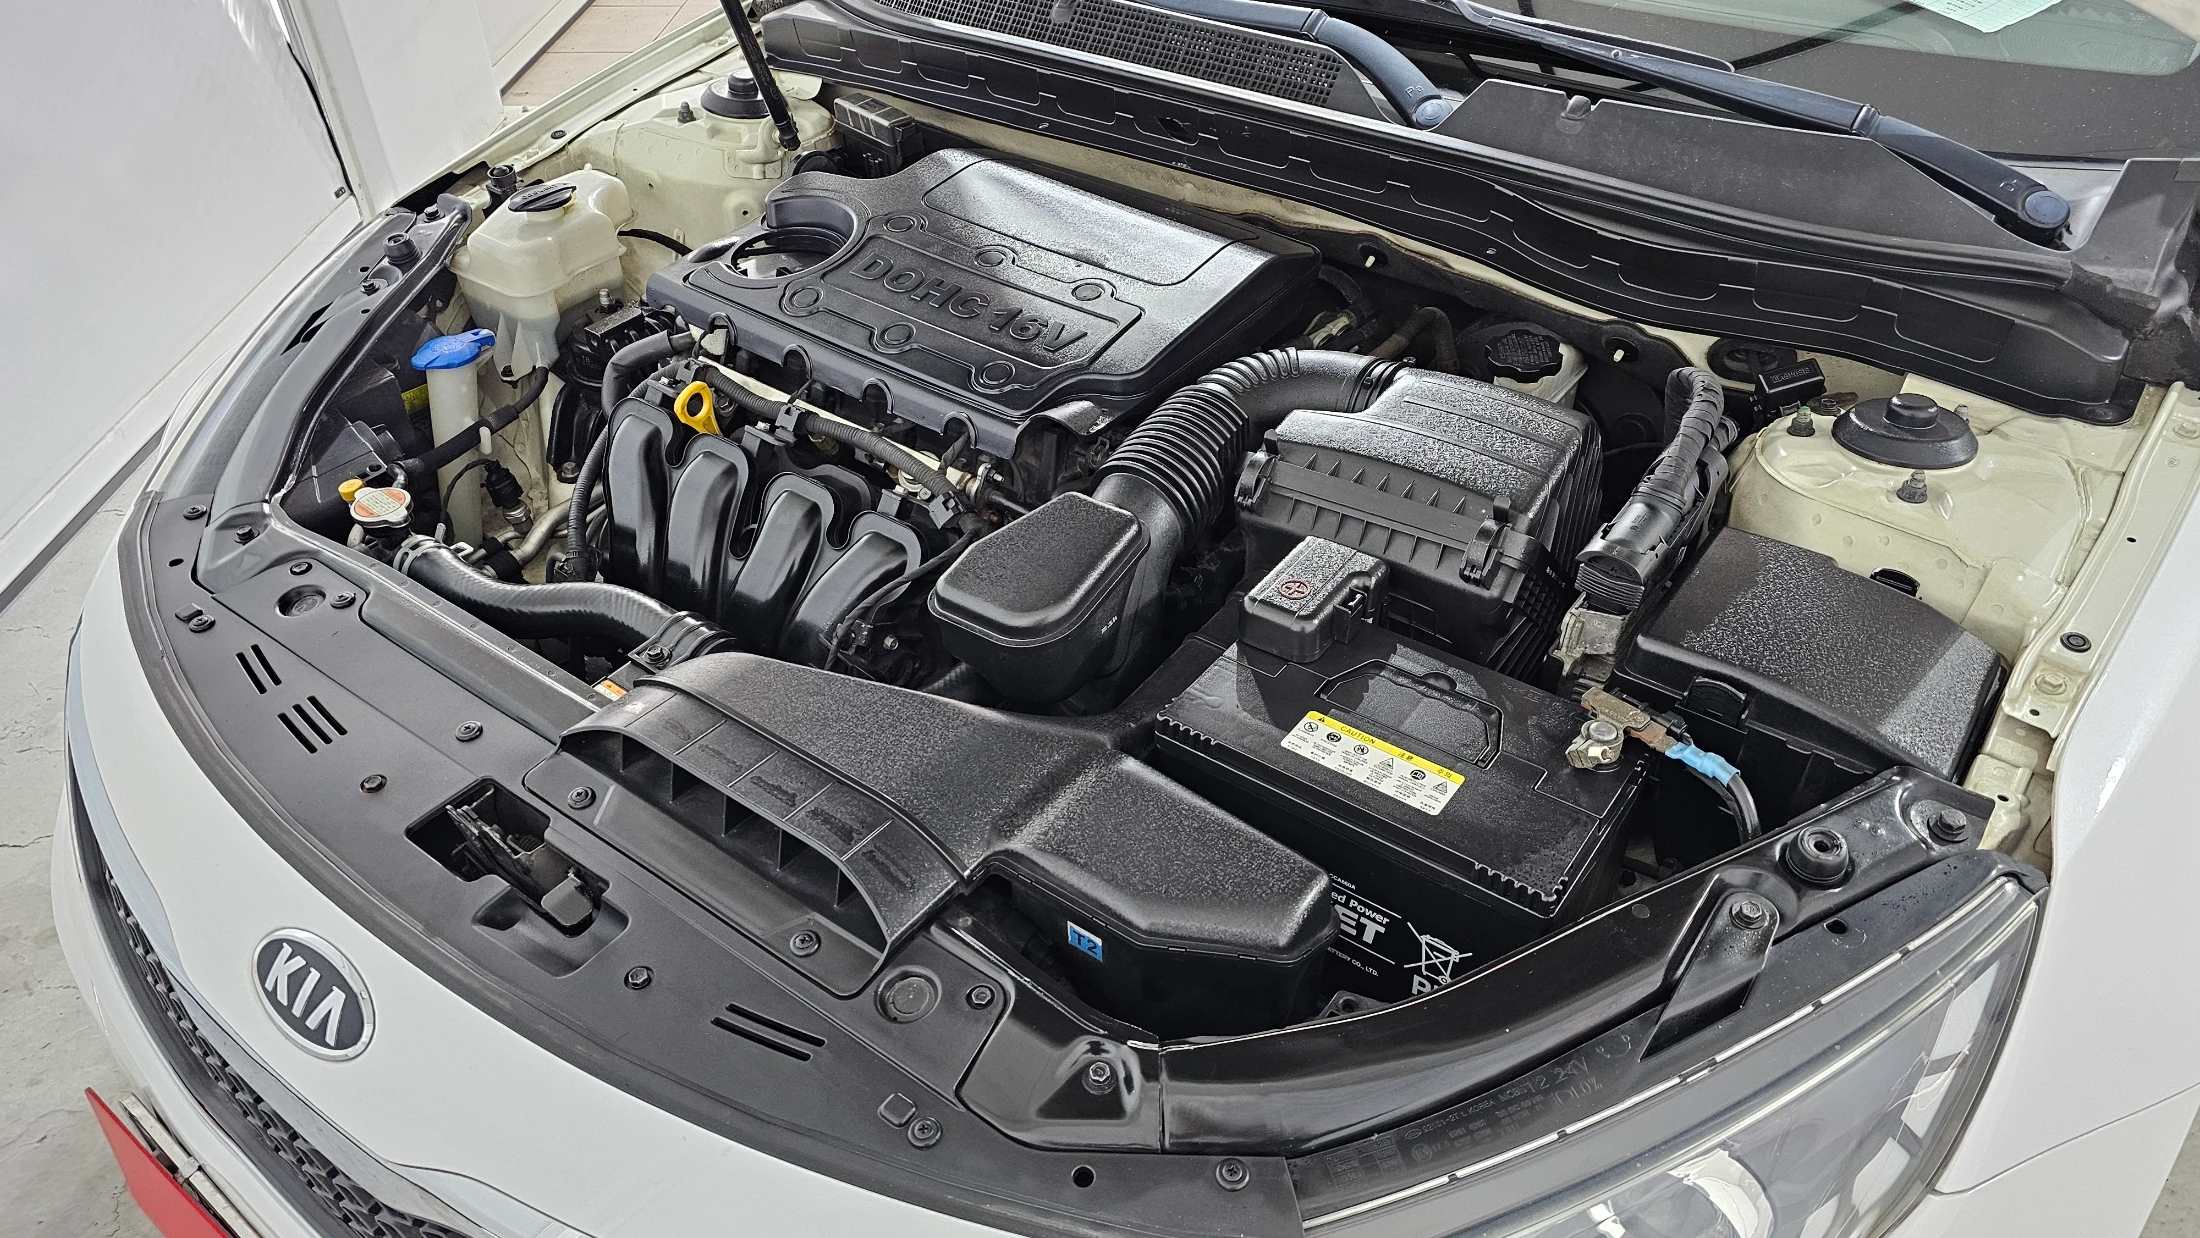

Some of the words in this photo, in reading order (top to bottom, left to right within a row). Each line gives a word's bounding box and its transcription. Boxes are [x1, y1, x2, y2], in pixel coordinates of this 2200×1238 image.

[849, 252, 990, 318] DOHC
[988, 305, 1089, 352] 16V
[1770, 366, 1811, 384] DIAGNOSIS
[1340, 725, 1376, 745] CAUTION
[1348, 899, 1390, 925] Power
[1072, 930, 1098, 956] T2
[1365, 965, 1379, 977] LTD.
[264, 942, 346, 1046] KIA
